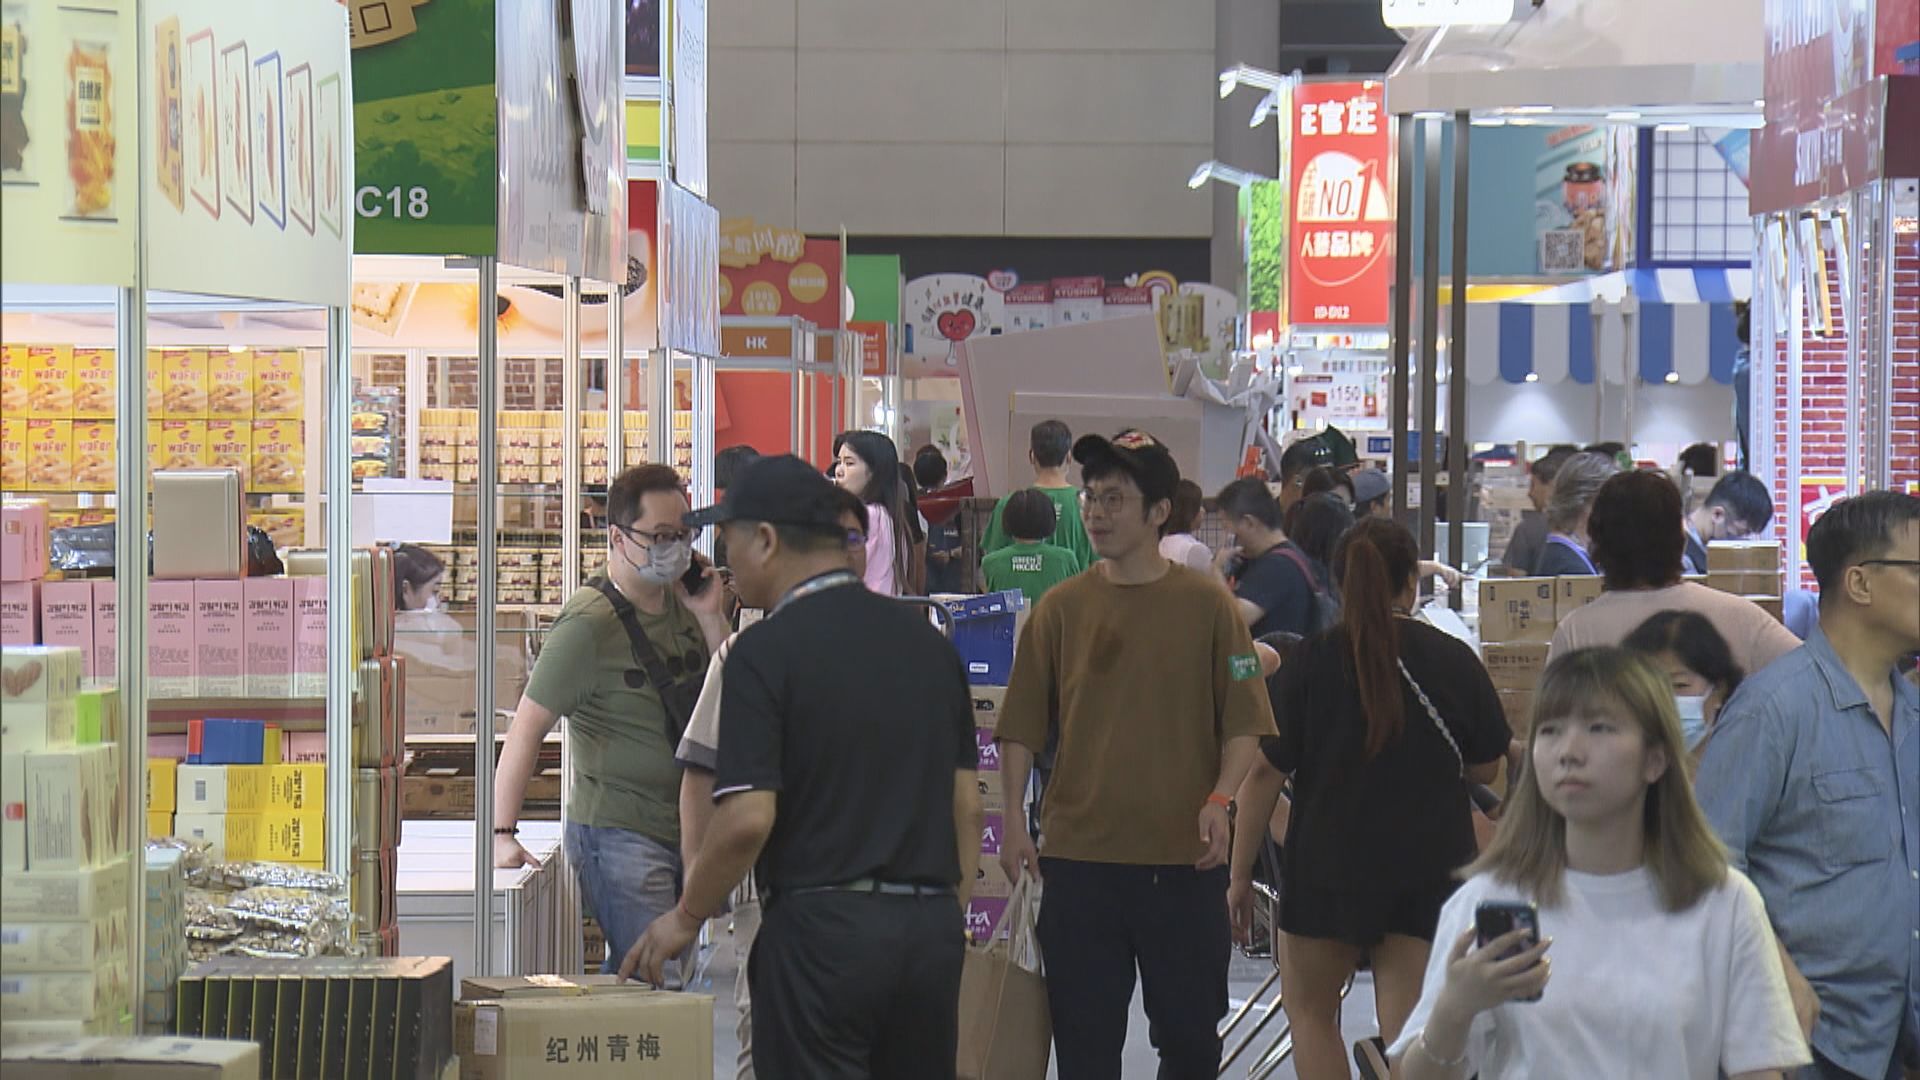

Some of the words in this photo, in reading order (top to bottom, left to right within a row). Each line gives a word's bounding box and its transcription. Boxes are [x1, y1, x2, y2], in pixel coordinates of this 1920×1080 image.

[1319, 159, 1379, 221] NO.1
[355, 186, 430, 219] C18
[1006, 294, 1045, 302] KYUSHIN
[1055, 286, 1098, 297] KYUSHIN
[745, 336, 767, 349] HK
[545, 1032, 661, 1064] 纪州青梅
